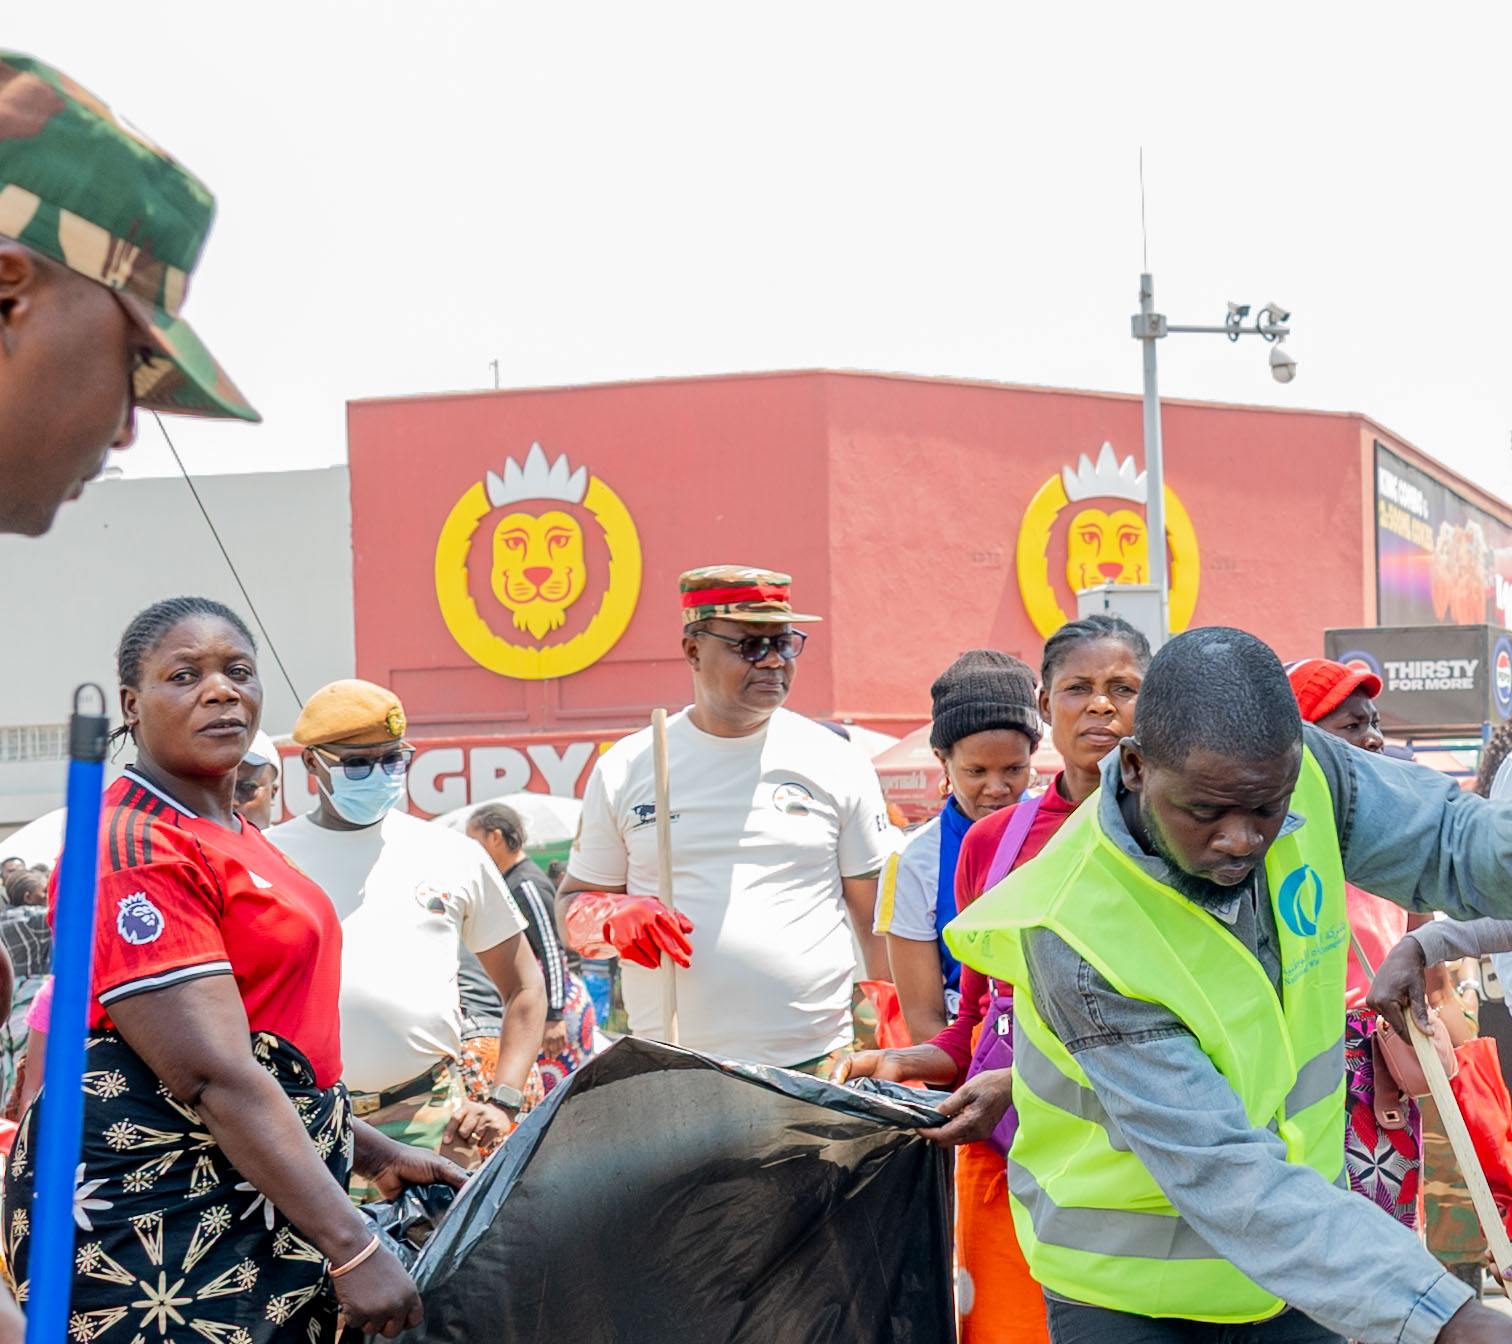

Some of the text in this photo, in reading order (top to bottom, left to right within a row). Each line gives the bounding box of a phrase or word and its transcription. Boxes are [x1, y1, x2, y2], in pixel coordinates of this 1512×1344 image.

[1384, 659, 1479, 680] THIRSTY
[1389, 676, 1473, 691] FOR MORE
